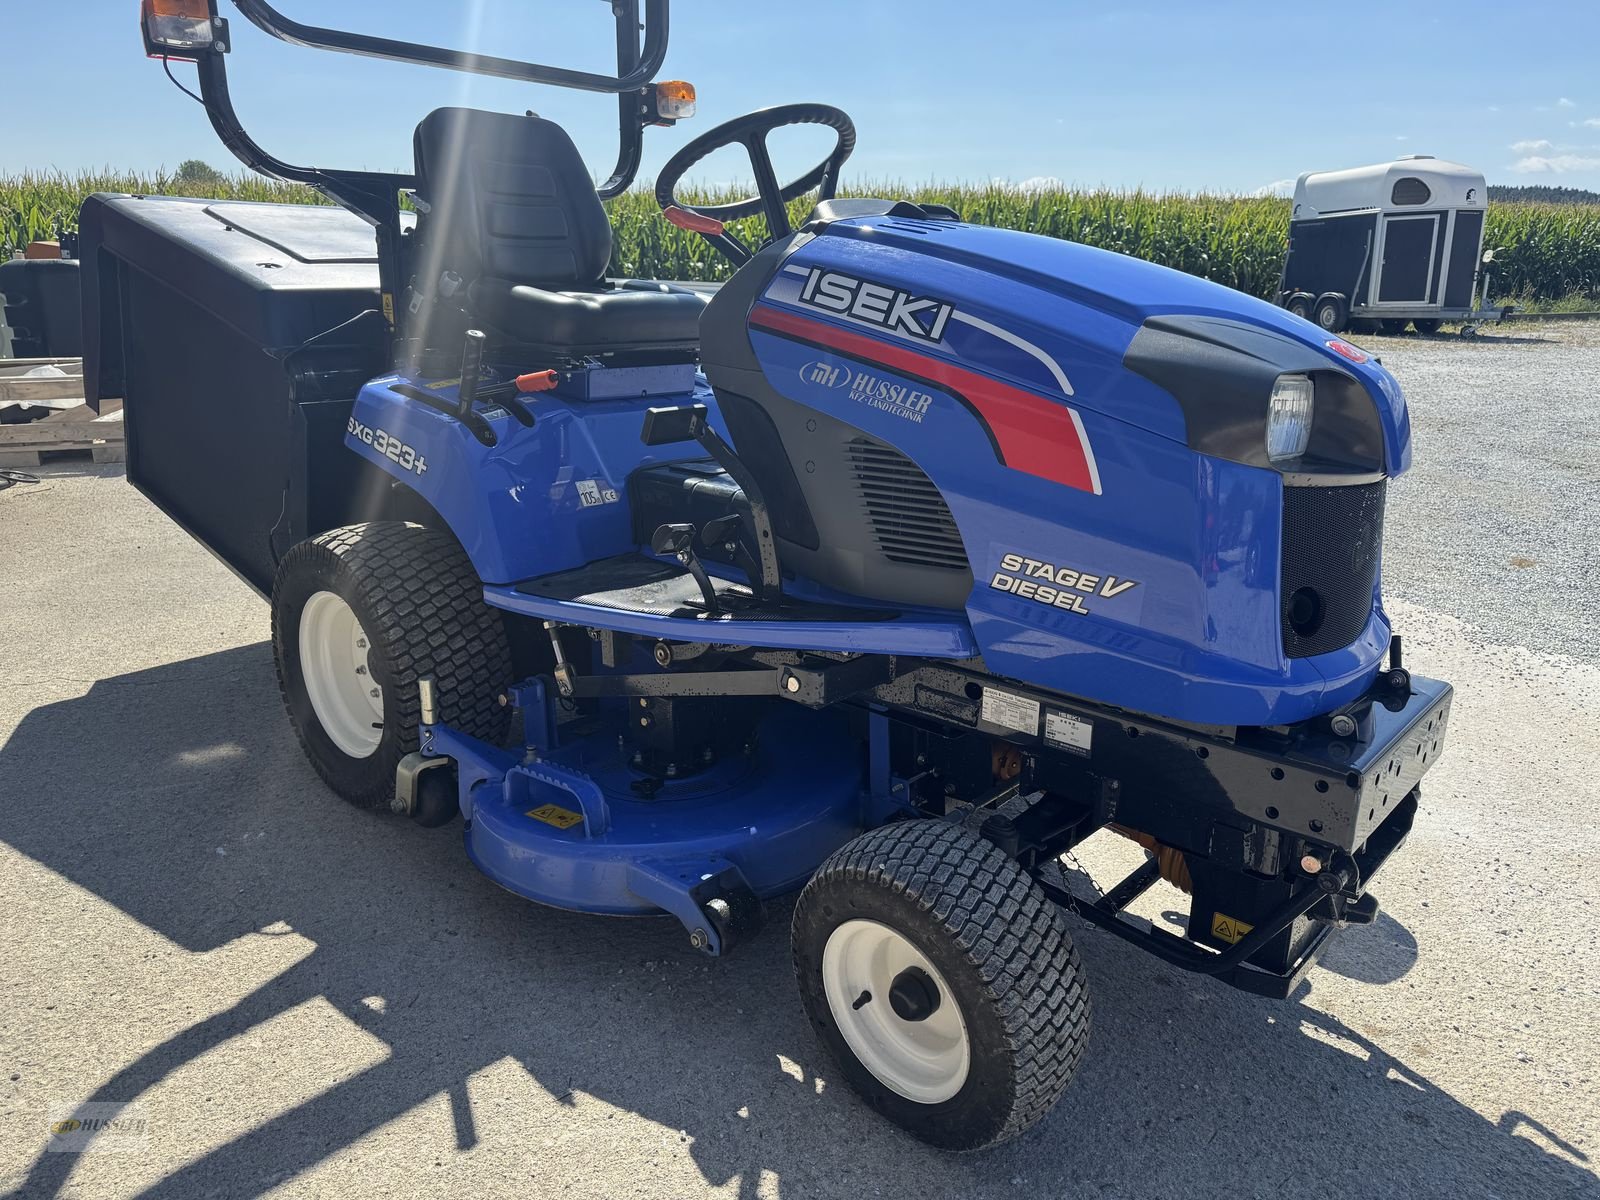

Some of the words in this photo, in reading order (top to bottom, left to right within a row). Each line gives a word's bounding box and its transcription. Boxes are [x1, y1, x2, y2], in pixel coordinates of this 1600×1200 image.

[800, 266, 955, 342] ISEKI
[852, 373, 933, 413] HUSSLER
[990, 573, 1090, 615] DIESEL
[1000, 553, 1099, 593] STAGE
[1100, 576, 1138, 598] V
